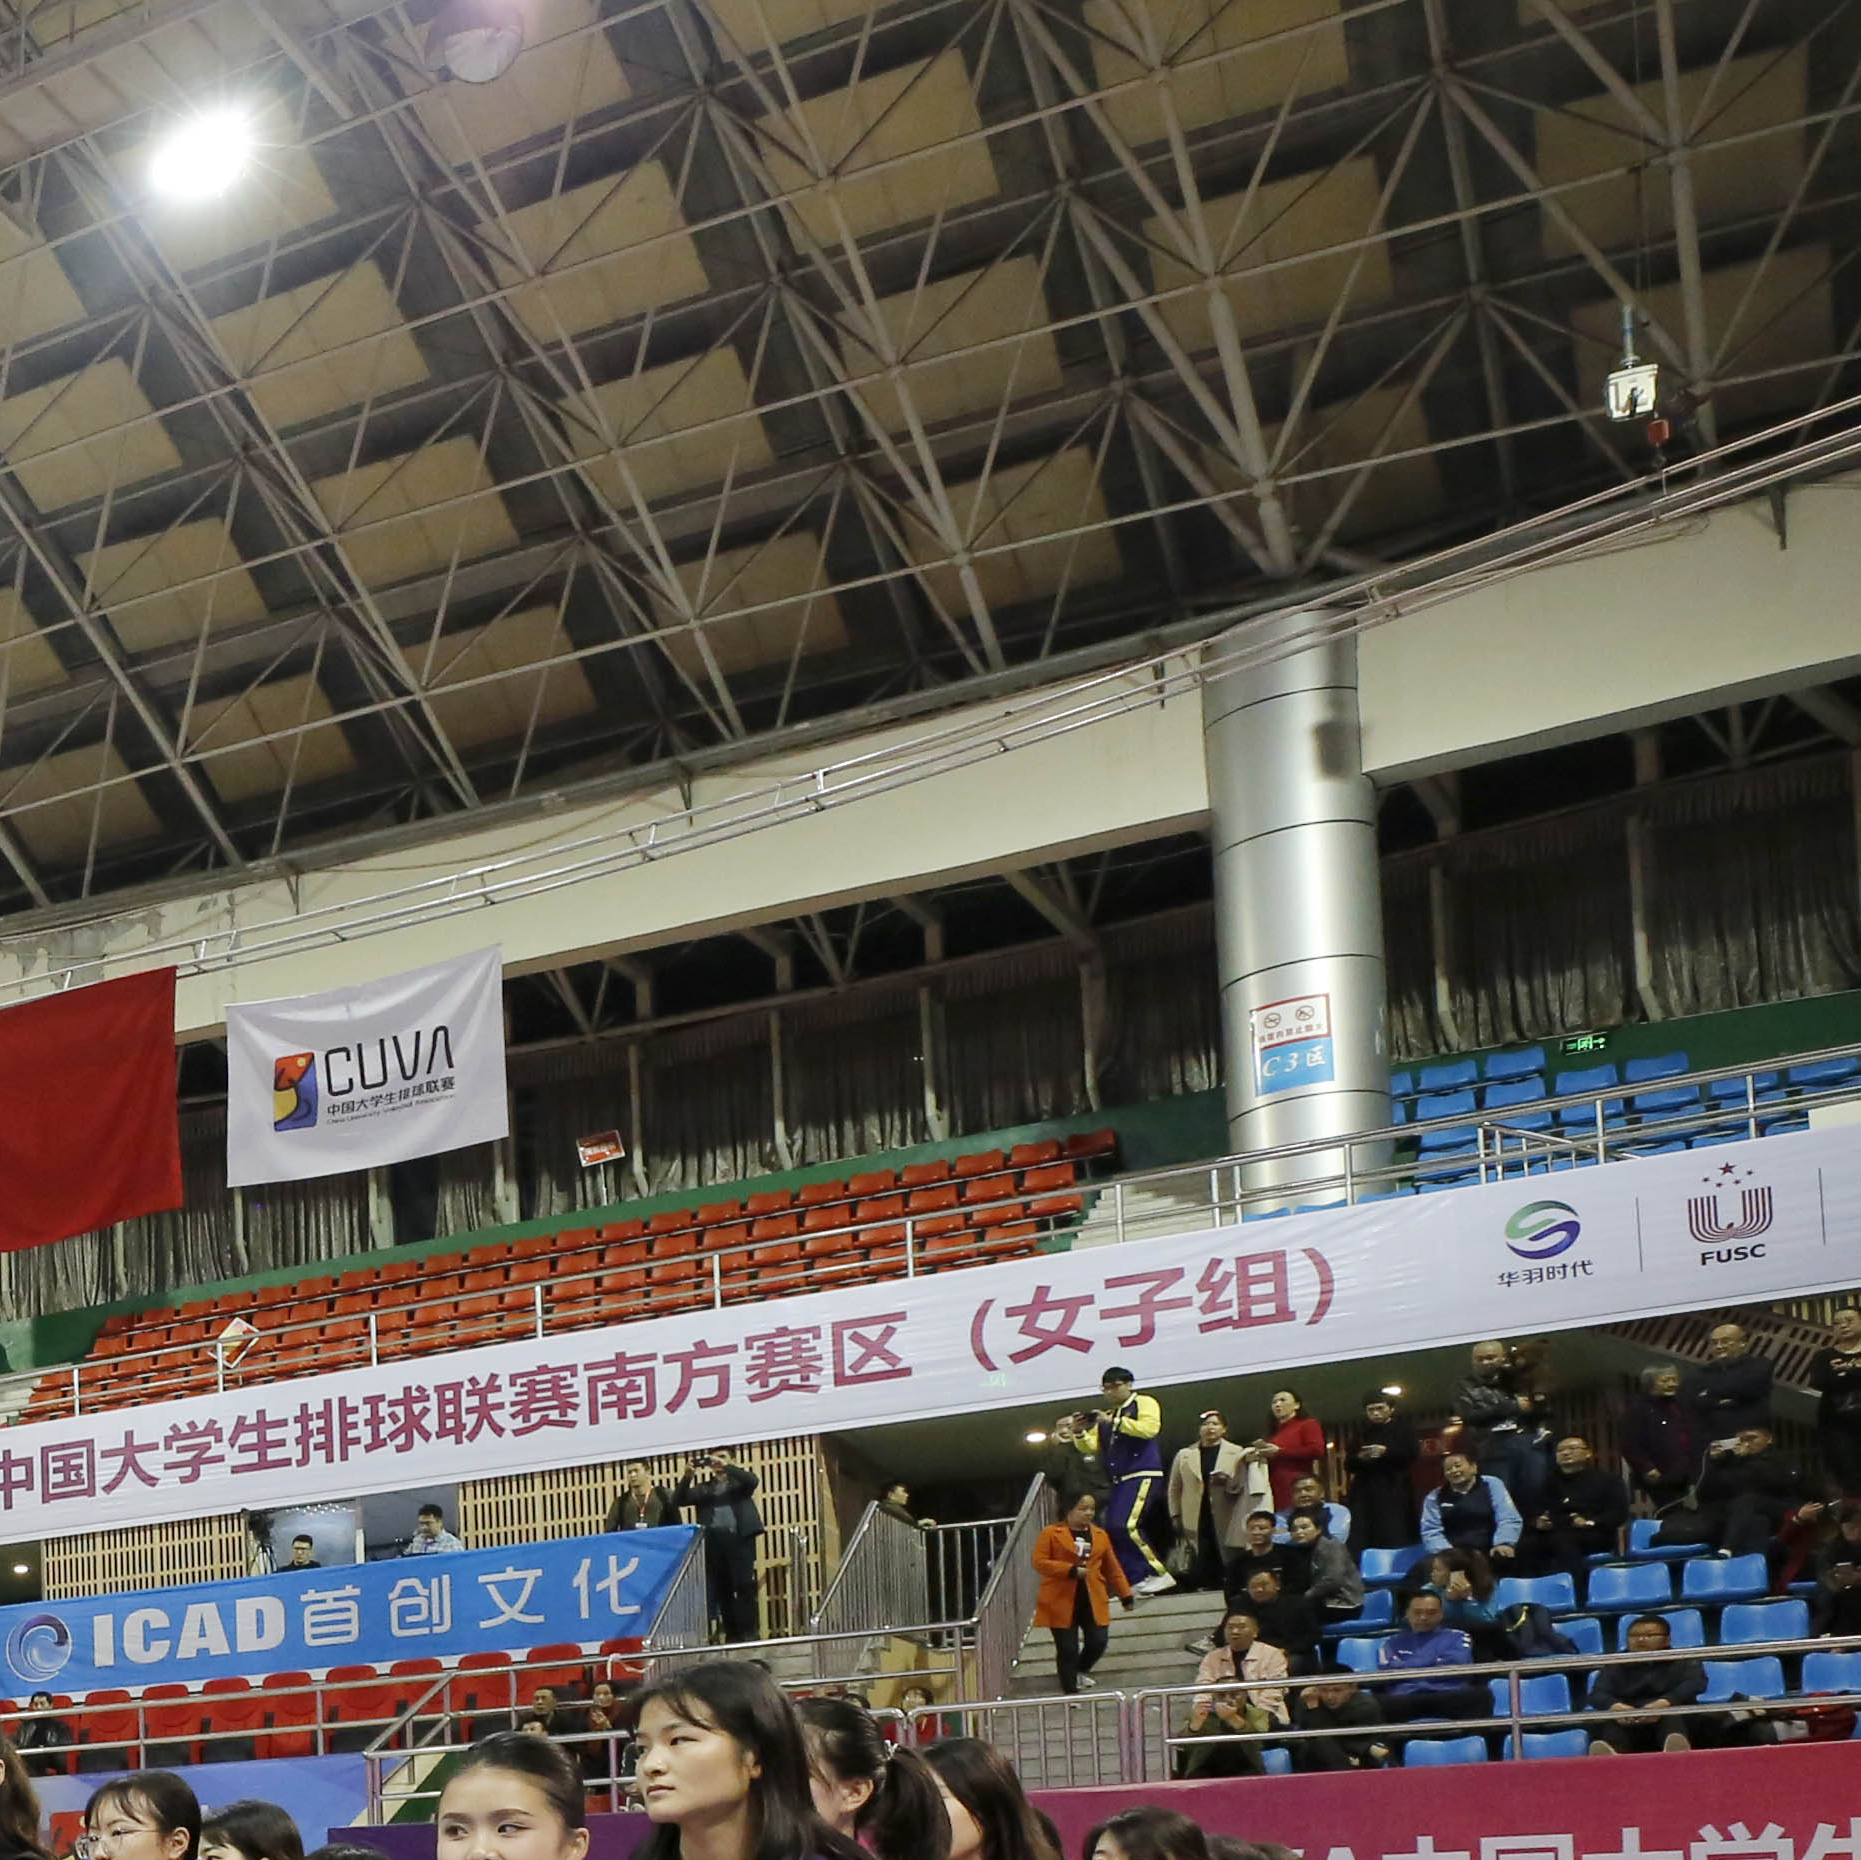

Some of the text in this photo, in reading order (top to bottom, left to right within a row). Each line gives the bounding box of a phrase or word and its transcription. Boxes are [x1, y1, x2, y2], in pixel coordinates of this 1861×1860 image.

[325, 1025, 455, 1096] CUVA
[327, 1077, 455, 1116] 中国大学生排球联赛
[1497, 1259, 1594, 1288] 华羽时代
[1700, 1242, 1766, 1266] FUSC
[93, 1552, 642, 1667] ICAD 首创文化
